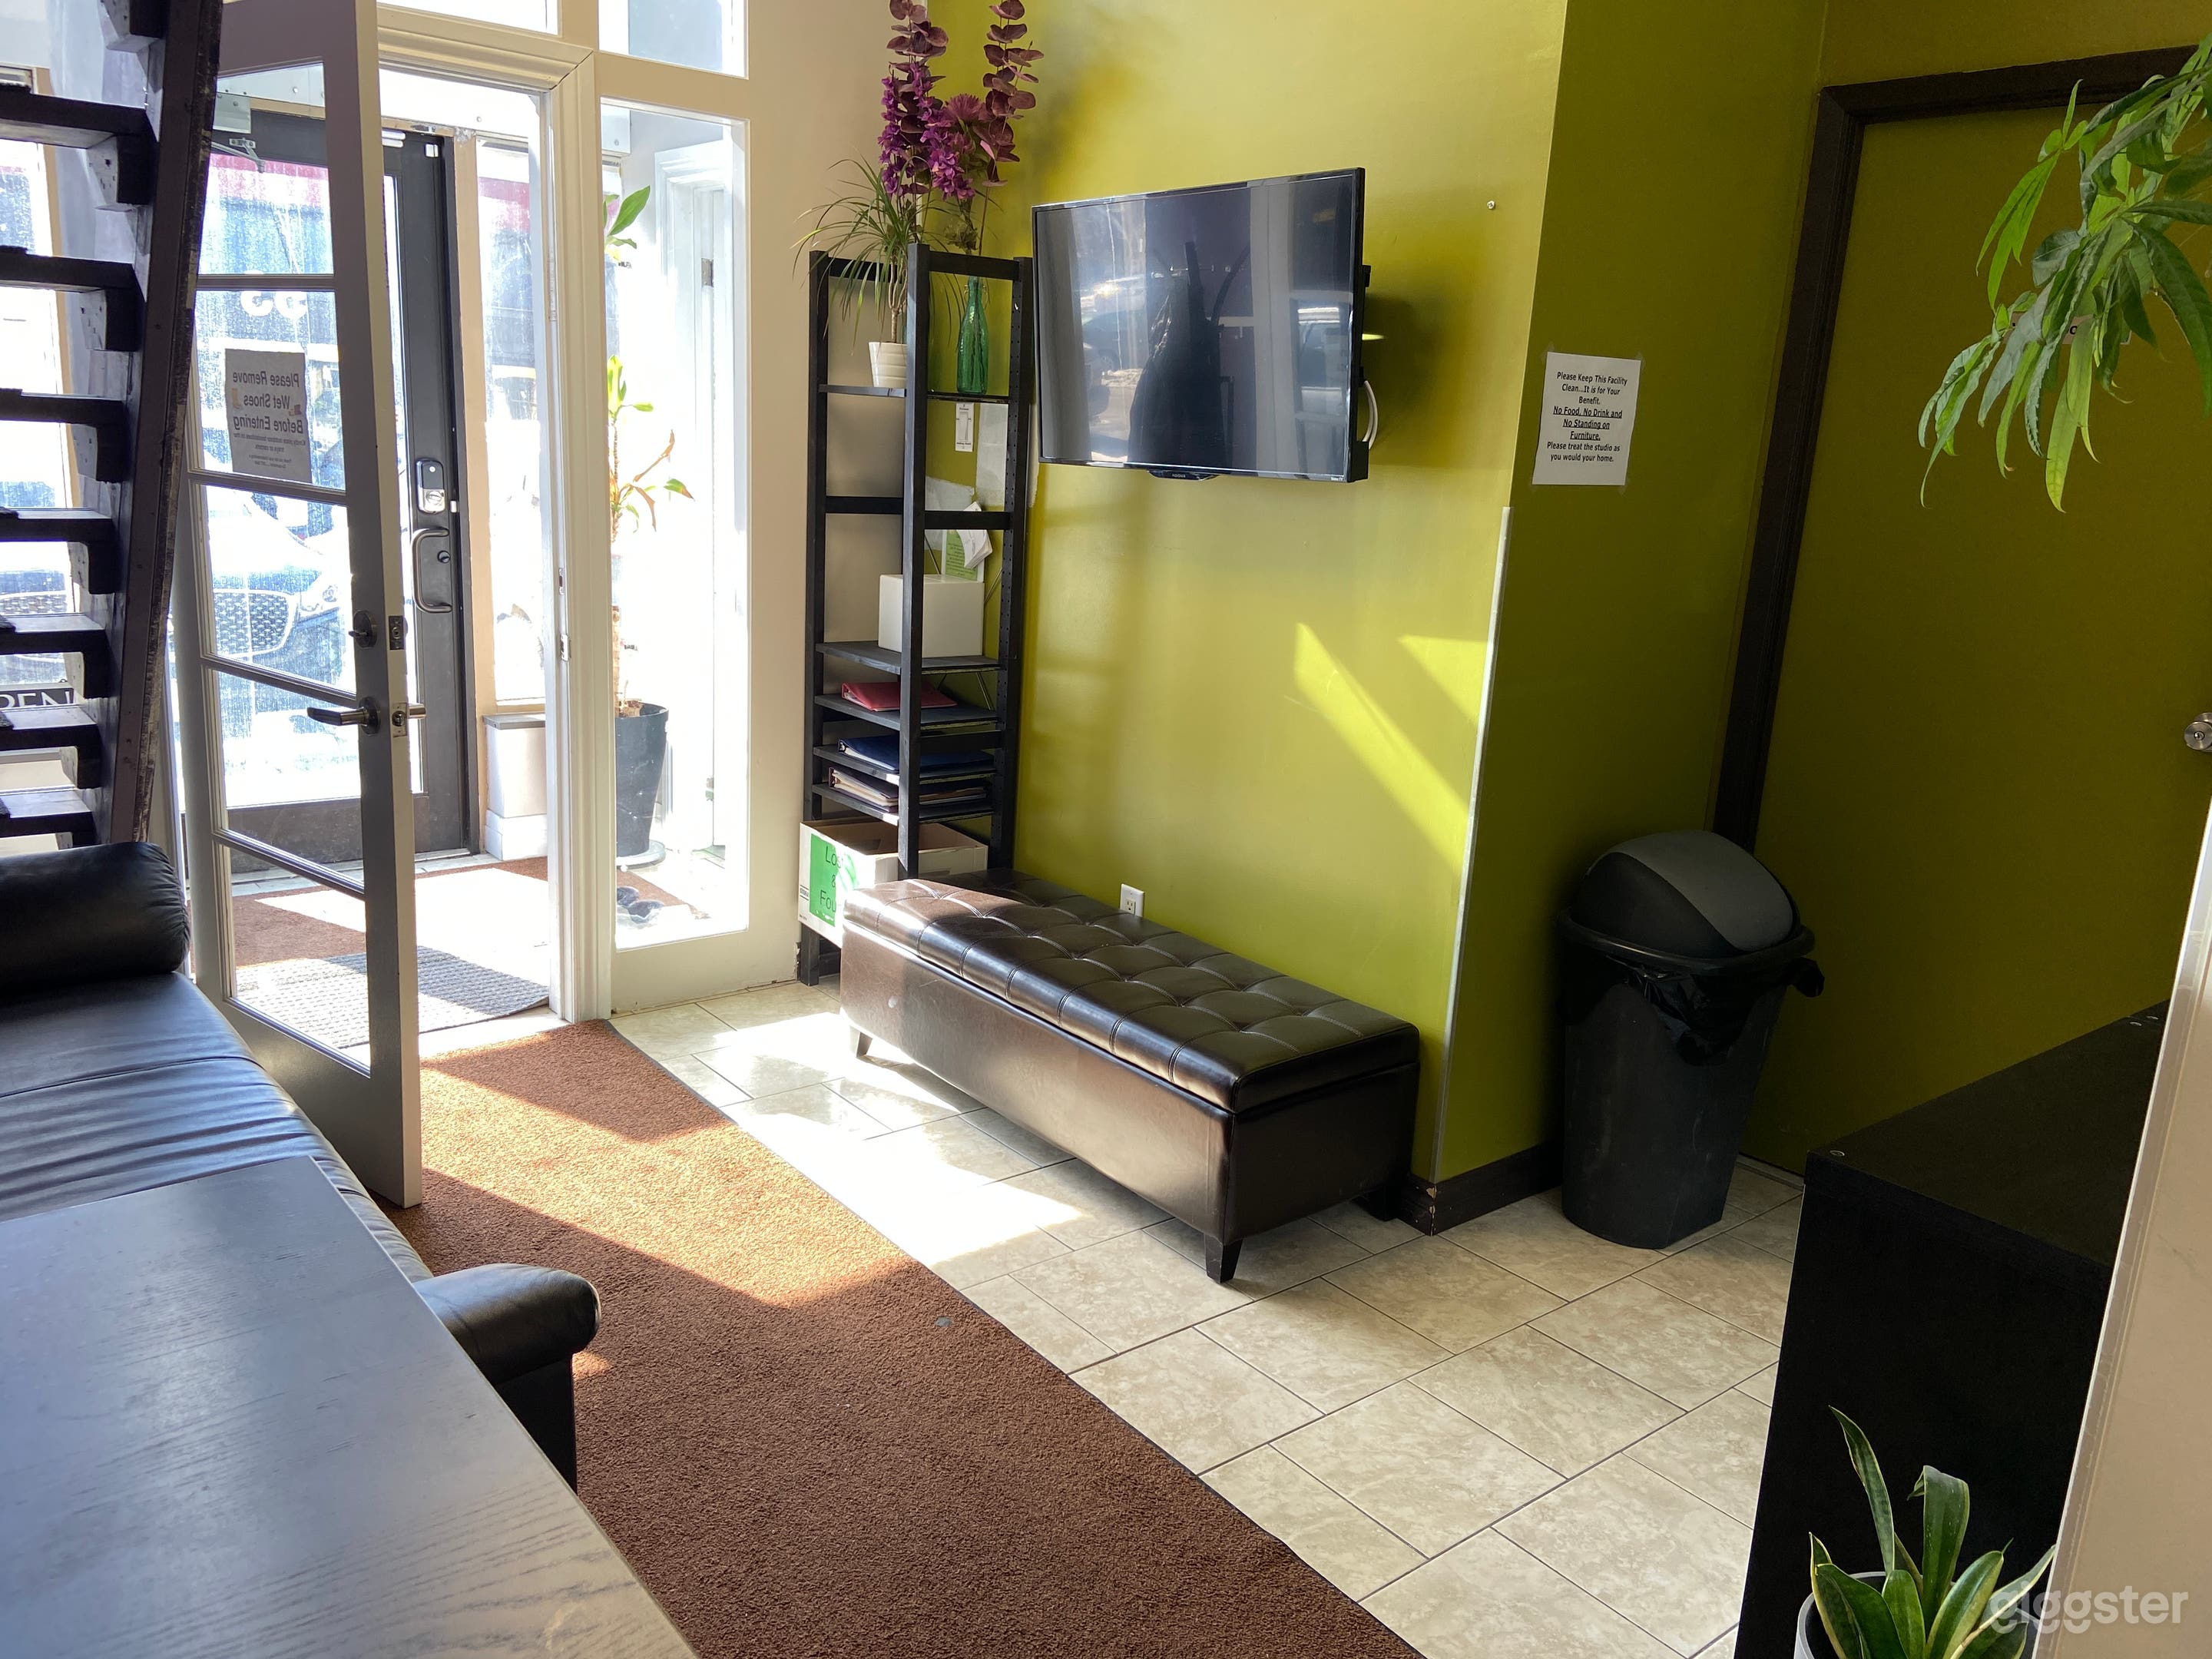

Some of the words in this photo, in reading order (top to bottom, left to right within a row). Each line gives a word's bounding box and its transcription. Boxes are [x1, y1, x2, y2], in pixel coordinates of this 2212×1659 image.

[1557, 372, 1576, 381] Please
[1578, 373, 1593, 383] Keep
[1594, 375, 1606, 383] This
[1608, 376, 1628, 386] Facility
[1607, 387, 1621, 396] Your
[1578, 396, 1601, 405] Benefit.
[1553, 406, 1562, 415] No
[1583, 408, 1592, 417] No
[1593, 409, 1610, 418] Drink
[1610, 410, 1623, 419] and
[1562, 419, 1572, 428] No
[1574, 419, 1601, 430] Standing
[1570, 431, 1601, 441] Furniture.
[832, 875, 836, 888] &
